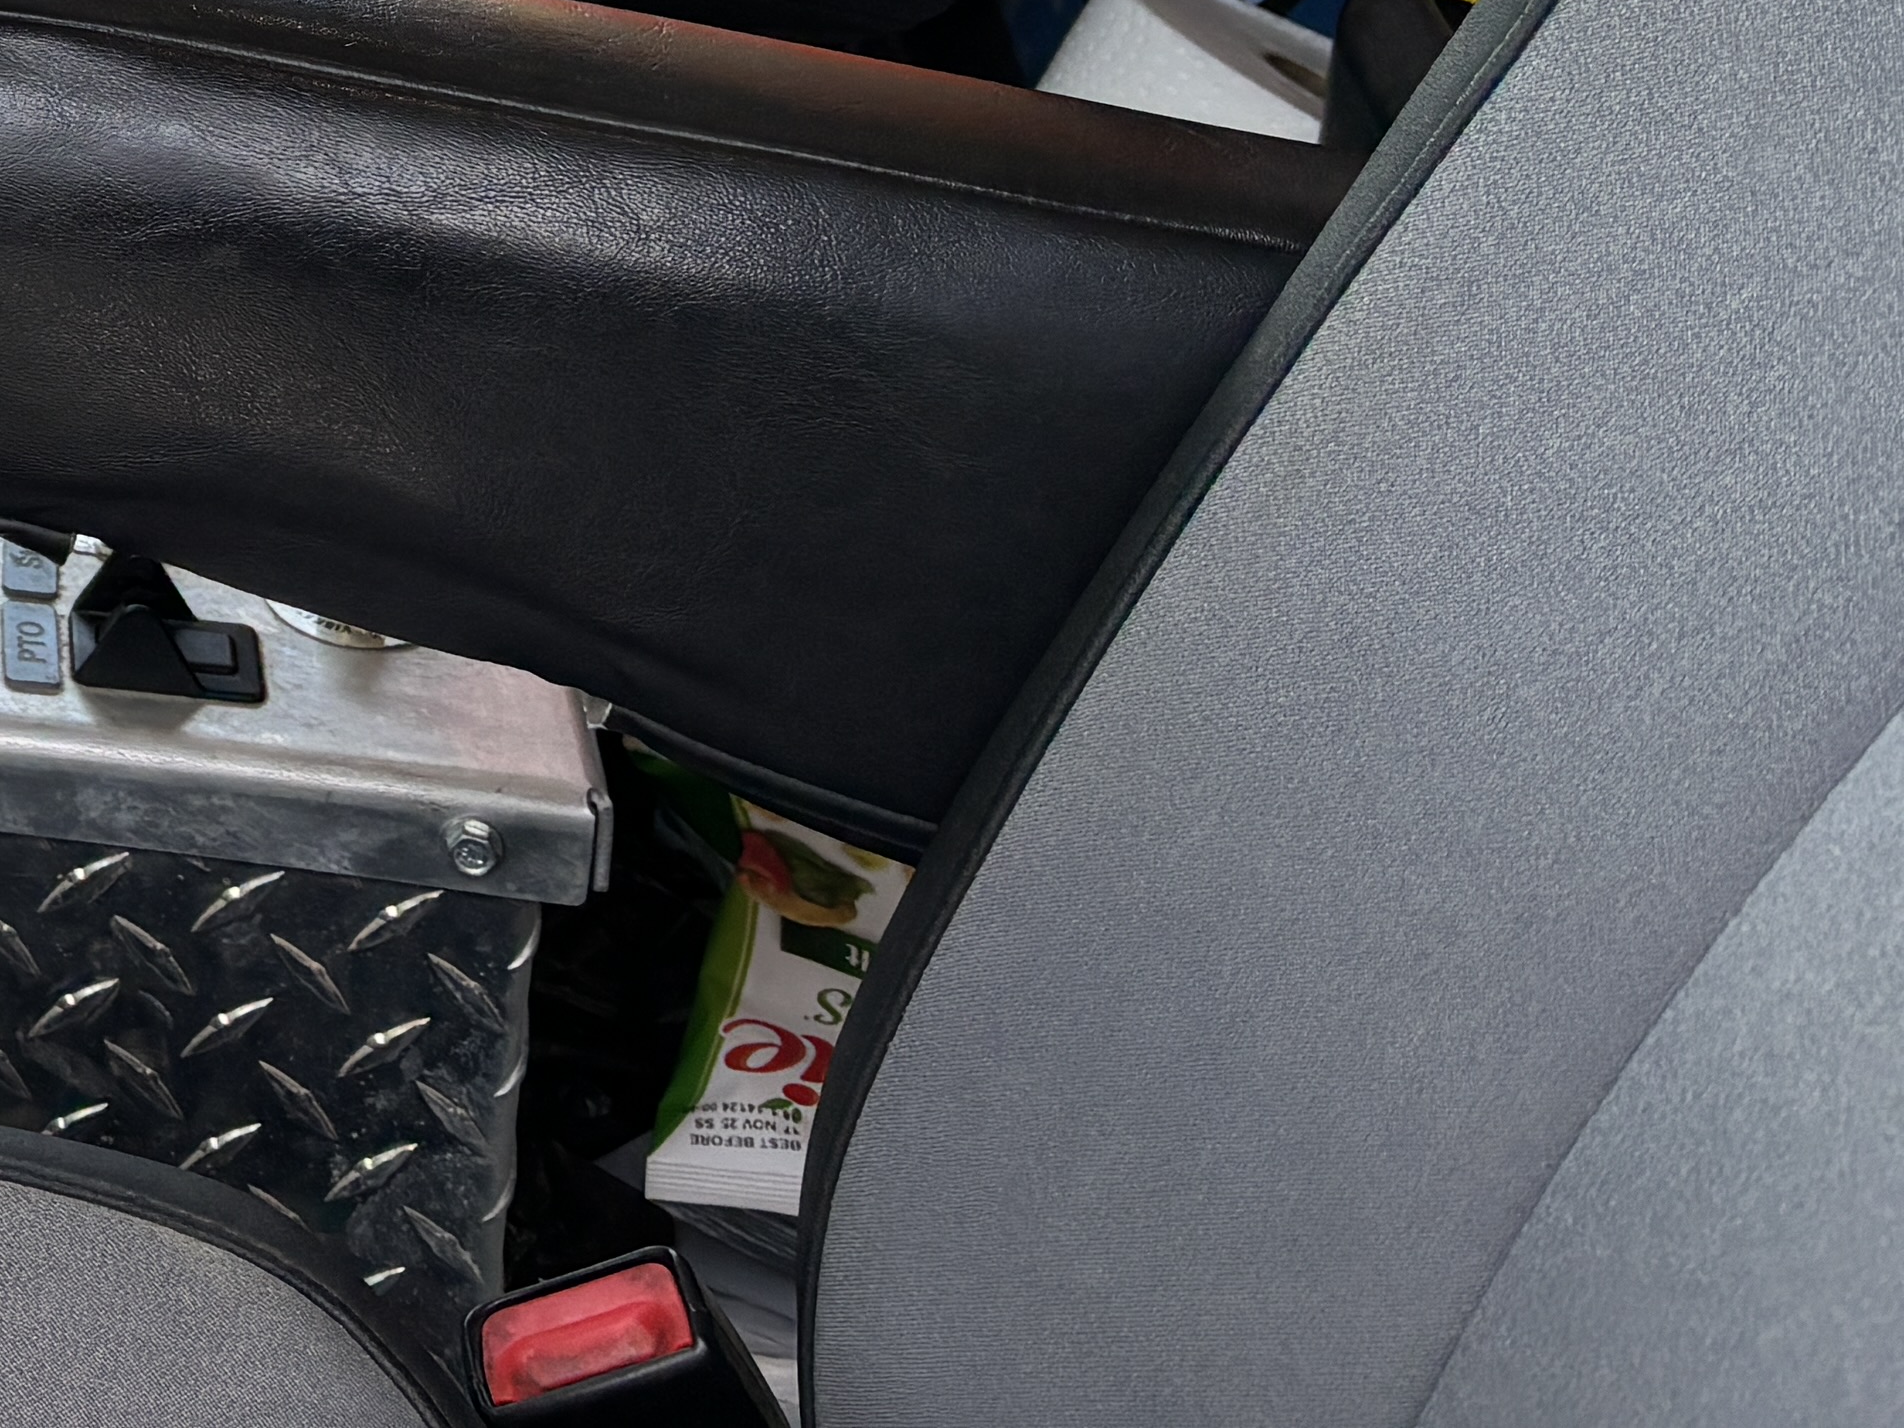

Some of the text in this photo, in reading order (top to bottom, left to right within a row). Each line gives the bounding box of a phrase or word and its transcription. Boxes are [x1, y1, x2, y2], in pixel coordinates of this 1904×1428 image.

[15, 620, 47, 664] PTO
[742, 1118, 776, 1132] NOV
[689, 1133, 802, 1151] BEST BEFORE
